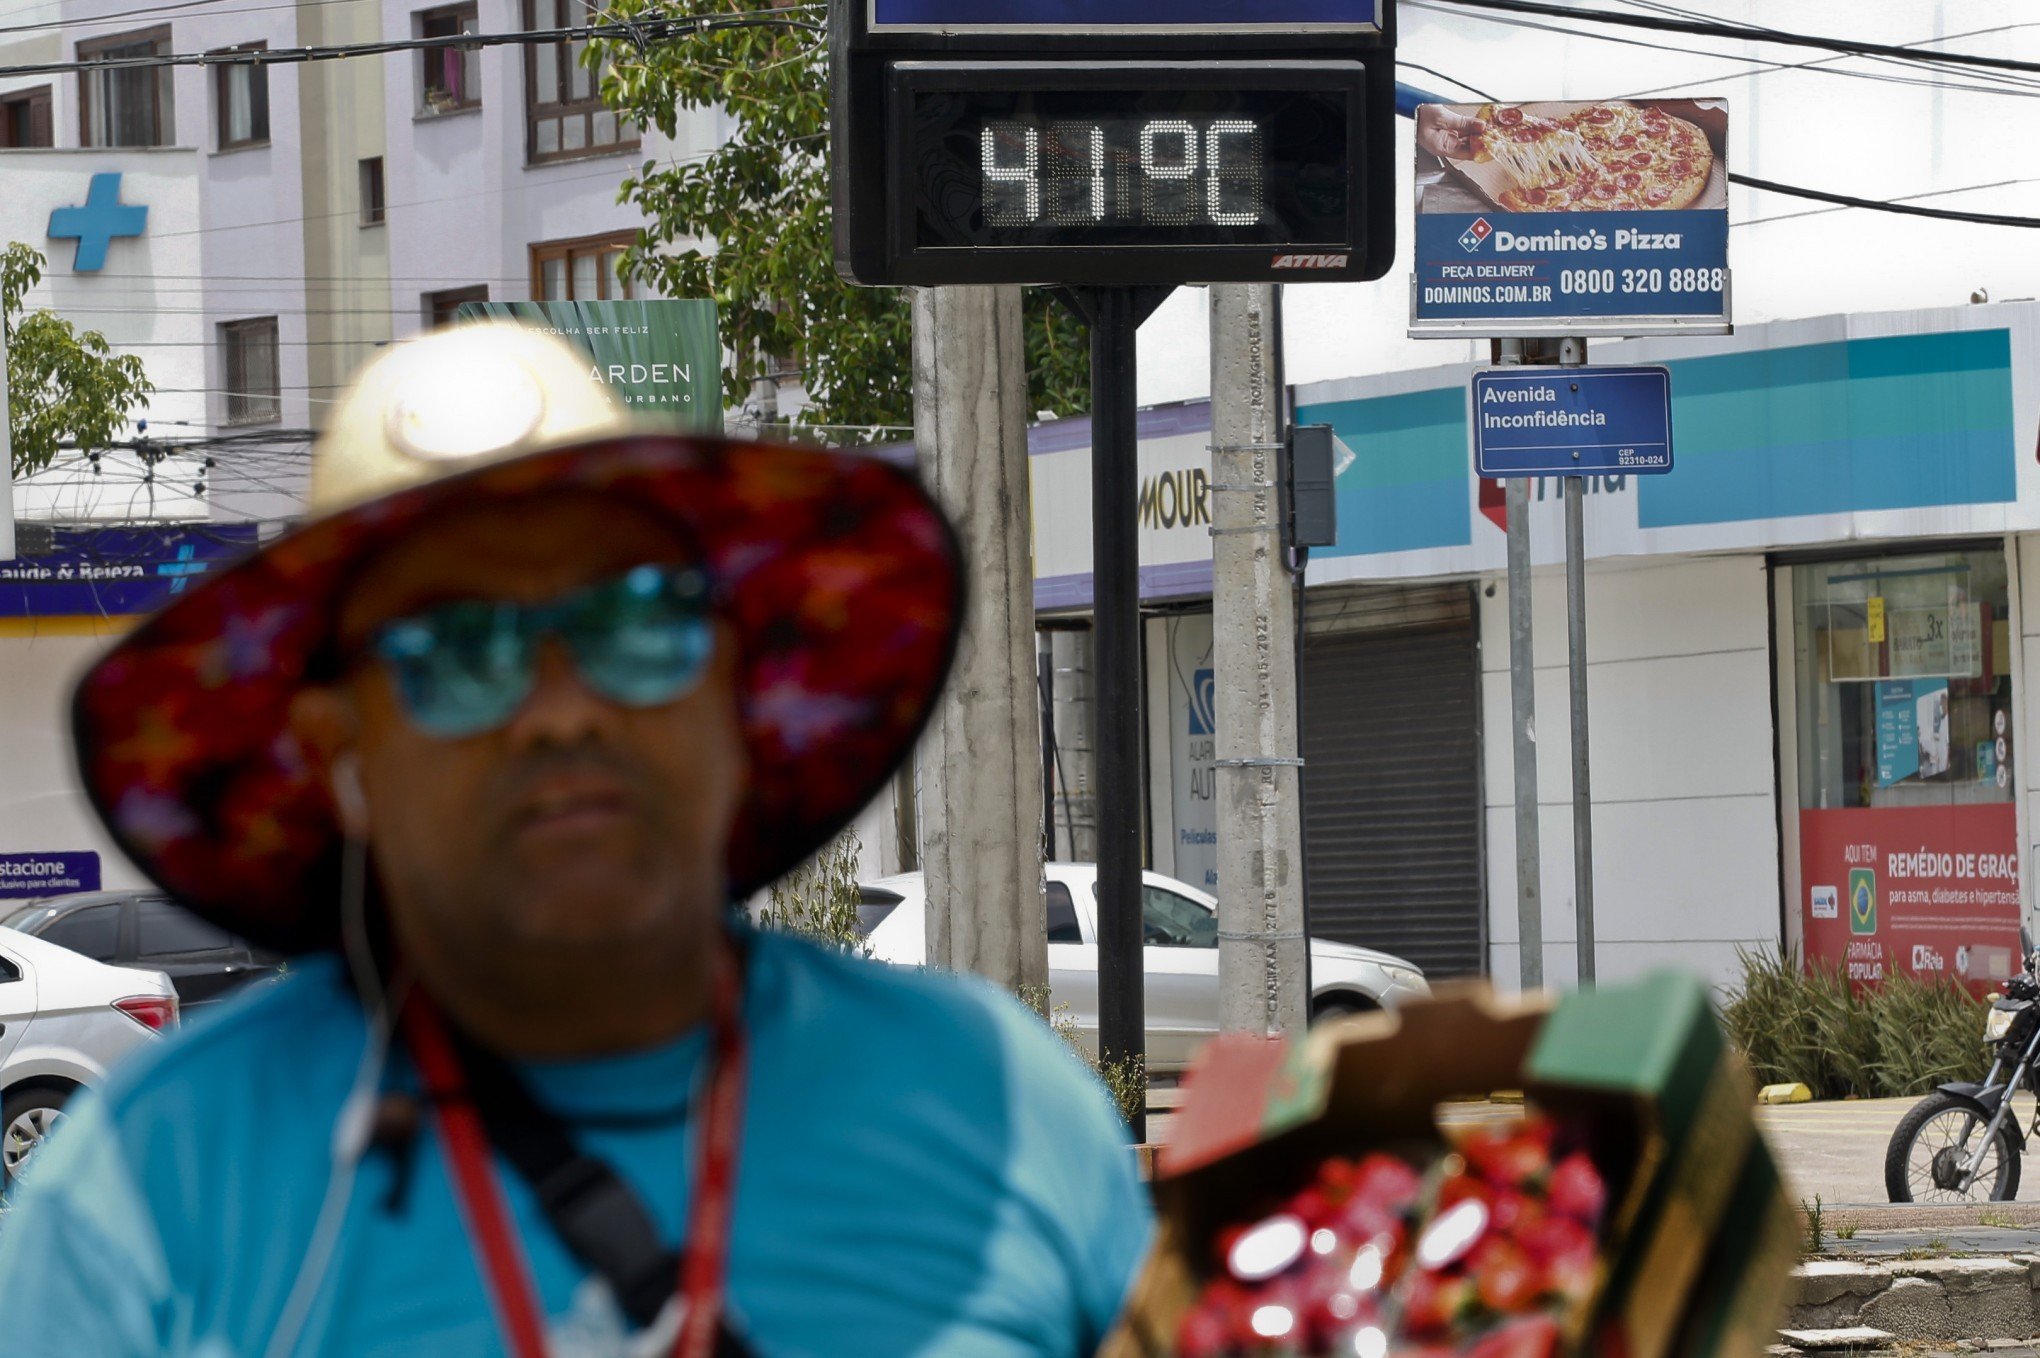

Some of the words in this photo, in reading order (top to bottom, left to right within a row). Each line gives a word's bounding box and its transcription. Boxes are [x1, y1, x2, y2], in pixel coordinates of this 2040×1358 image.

[1495, 228, 1608, 252] Domino's
[1615, 227, 1682, 250] Pizza
[1271, 254, 1348, 268] ATIVA
[1442, 265, 1474, 280] PEÇA
[1477, 265, 1536, 277] DELIVERY
[1560, 269, 1615, 294] 0800
[1621, 268, 1662, 293] 320
[1669, 268, 1723, 293] 8888
[1425, 285, 1552, 304] DOMINOS.COM.BR
[528, 327, 580, 335] ESCOLHA
[586, 326, 609, 335] SER
[614, 326, 649, 335] FELIZ
[589, 364, 690, 384] ARDEN
[625, 394, 691, 403] URBANO
[1483, 386, 1556, 403] Avenida
[1484, 409, 1606, 429] Inconfidência
[1618, 456, 1664, 465] 92310-024
[1888, 846, 1953, 878] REMÉDIO
[1955, 853, 1976, 878] DE
[1978, 853, 2017, 885] GRAÇ
[27, 880, 46, 890] para
[47, 877, 81, 888] clientes
[1889, 890, 1906, 906] para
[1907, 890, 1931, 905] asma,
[1932, 887, 1968, 904] diabetes
[1969, 891, 1975, 903] e
[1848, 938, 1882, 959] FARMÁCIA
[1924, 951, 1944, 970] Raia
[1848, 963, 1882, 980] POPULAR
